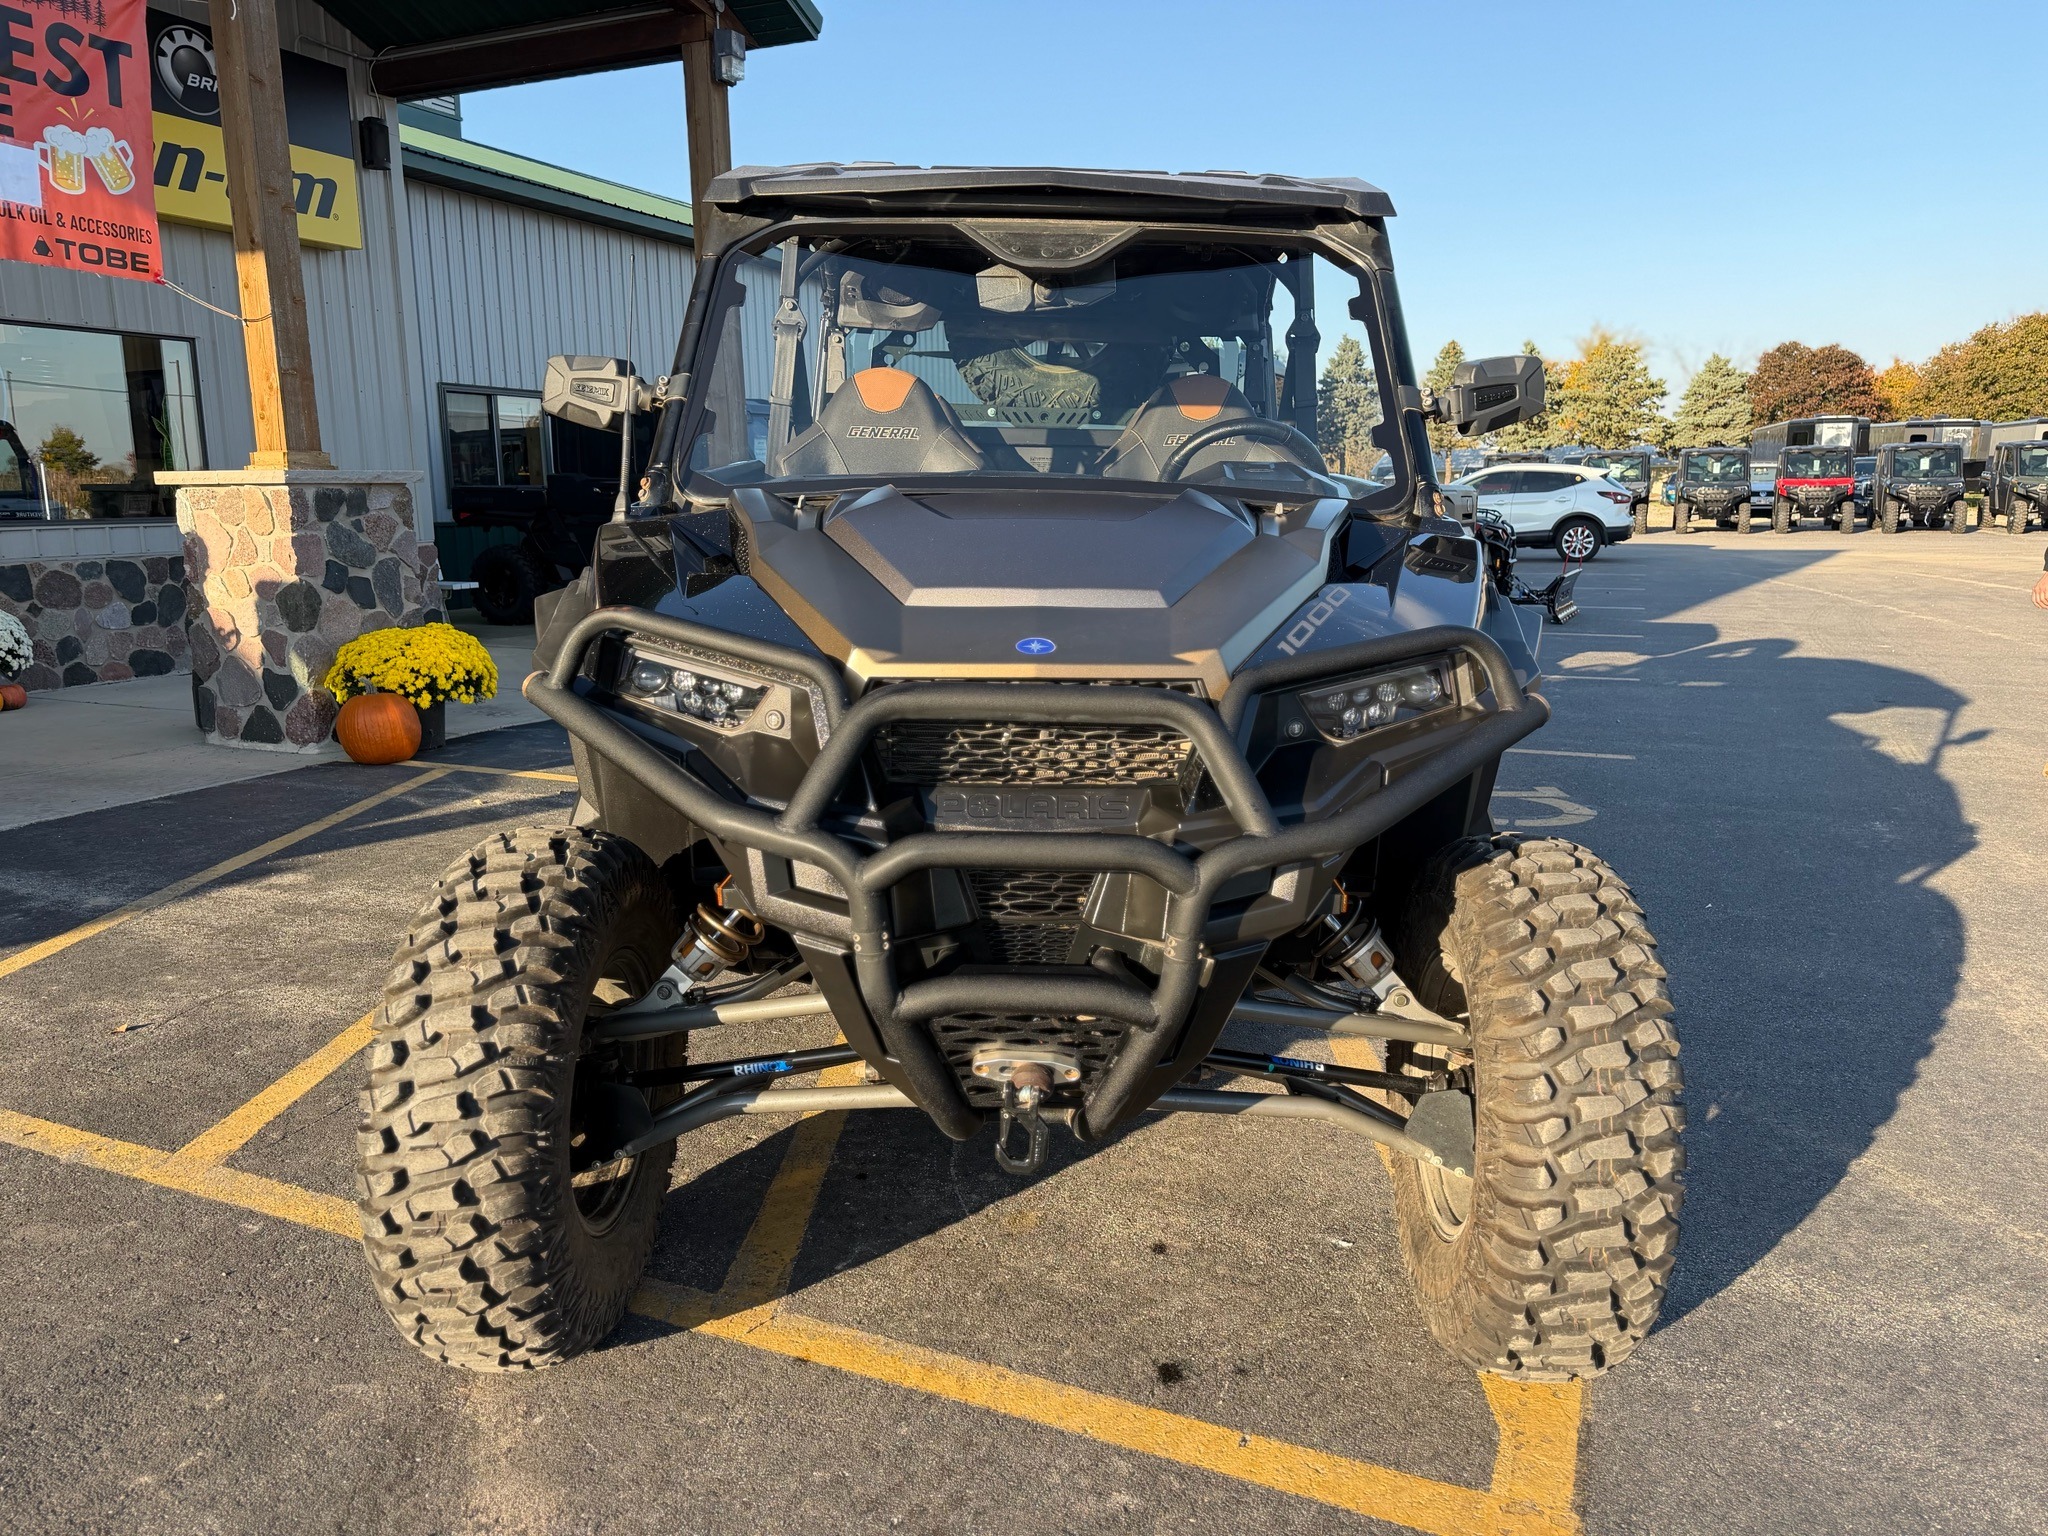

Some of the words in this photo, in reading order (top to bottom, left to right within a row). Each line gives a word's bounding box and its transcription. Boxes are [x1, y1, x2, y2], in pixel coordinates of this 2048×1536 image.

[30, 206, 52, 226] OIL
[56, 212, 66, 229] &
[70, 215, 152, 244] ACCESSORIES
[55, 238, 150, 273] TOBE
[847, 425, 920, 440] GENERAL
[1277, 586, 1352, 656] 1000
[936, 794, 1130, 819] POLARIS
[733, 1060, 777, 1076] RHINO
